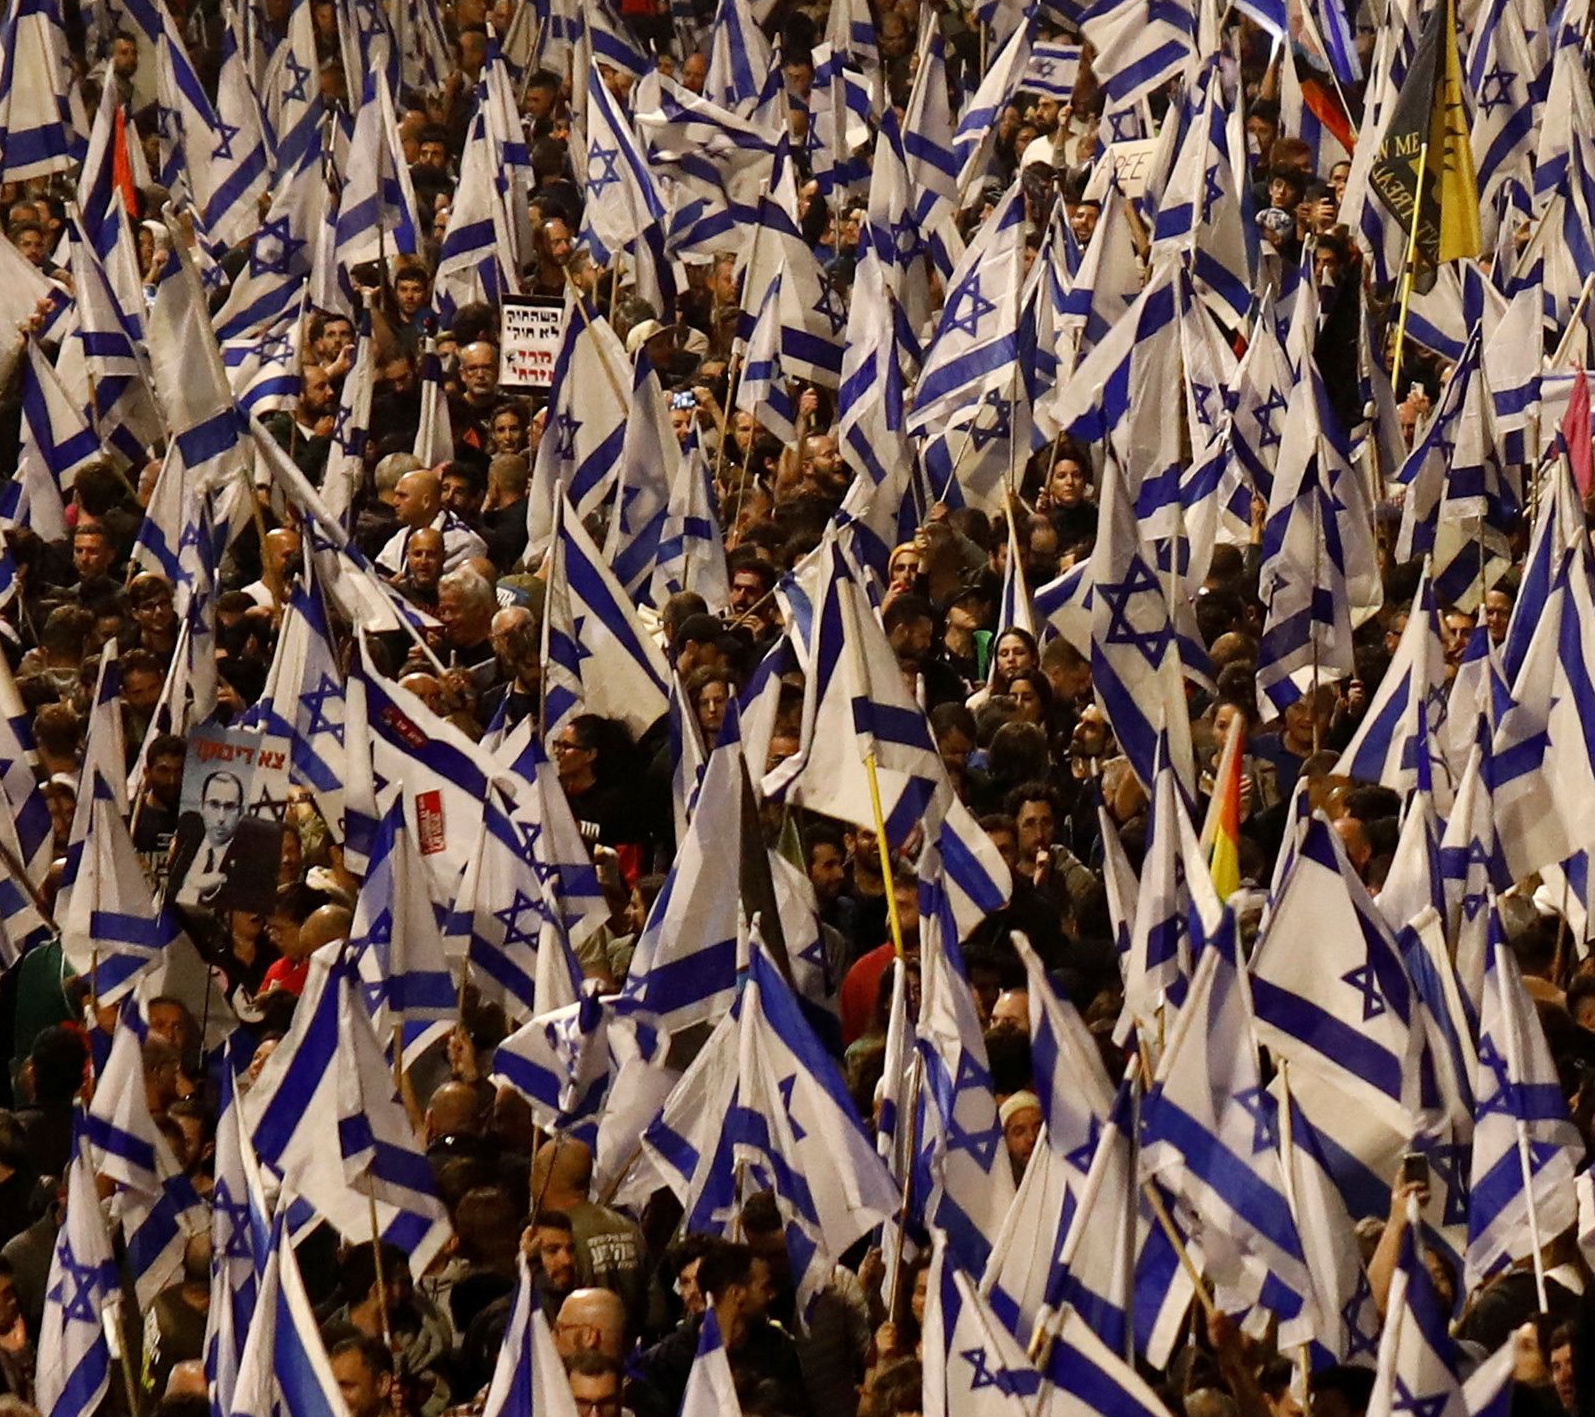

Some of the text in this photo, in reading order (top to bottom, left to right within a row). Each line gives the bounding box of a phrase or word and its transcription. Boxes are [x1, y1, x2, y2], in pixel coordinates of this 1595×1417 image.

[1394, 131, 1421, 158] ME
[1094, 151, 1154, 183] FREE
[506, 309, 559, 323] כשהחוק
[506, 326, 559, 340] לא חוקי
[518, 350, 552, 363] מרד
[258, 750, 286, 770] צא
